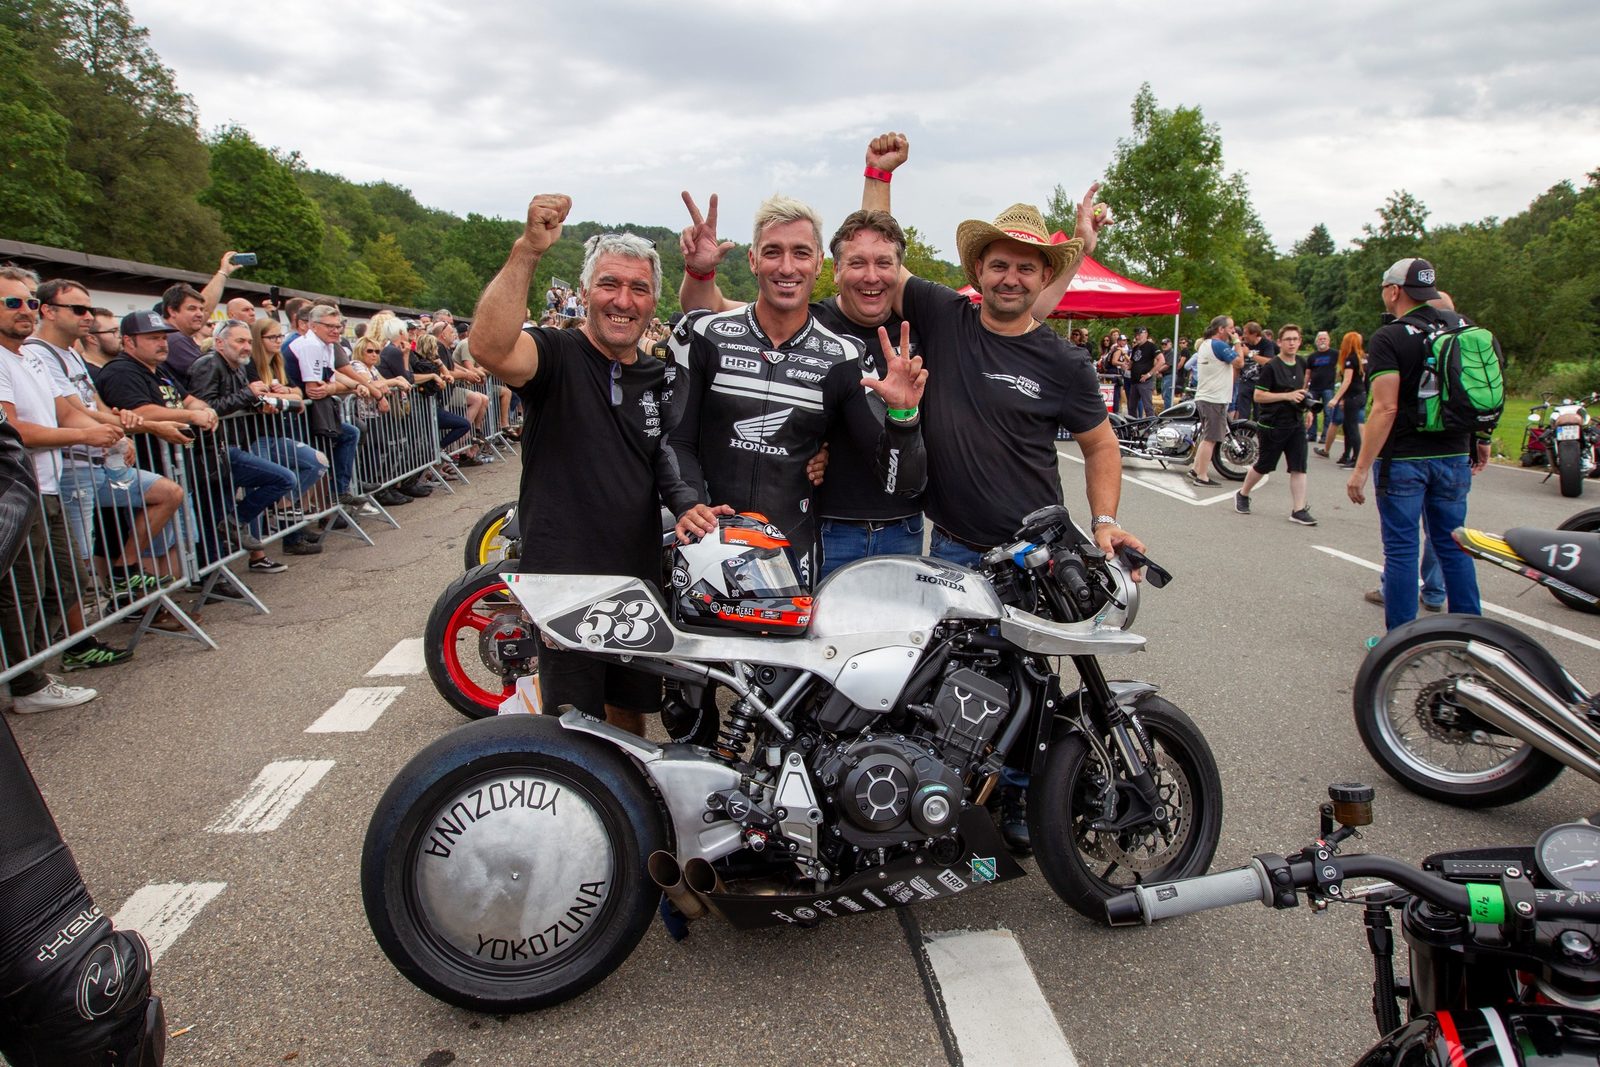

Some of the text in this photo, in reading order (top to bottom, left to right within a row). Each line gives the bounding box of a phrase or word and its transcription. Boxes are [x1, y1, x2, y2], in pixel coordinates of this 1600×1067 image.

[713, 322, 745, 333] Arai
[727, 343, 760, 354] MOTOREX
[725, 357, 757, 369] HRP
[788, 352, 833, 369] TCX
[796, 369, 827, 383] MNKY
[729, 438, 789, 456] HONDA
[1540, 543, 1582, 571] 13
[916, 573, 967, 593] HONDA
[735, 605, 756, 618] REBEL
[575, 600, 661, 648] 53
[425, 779, 561, 859] YOKOZUNA
[942, 872, 965, 890] HRP
[475, 880, 606, 961] YOKOZUNA
